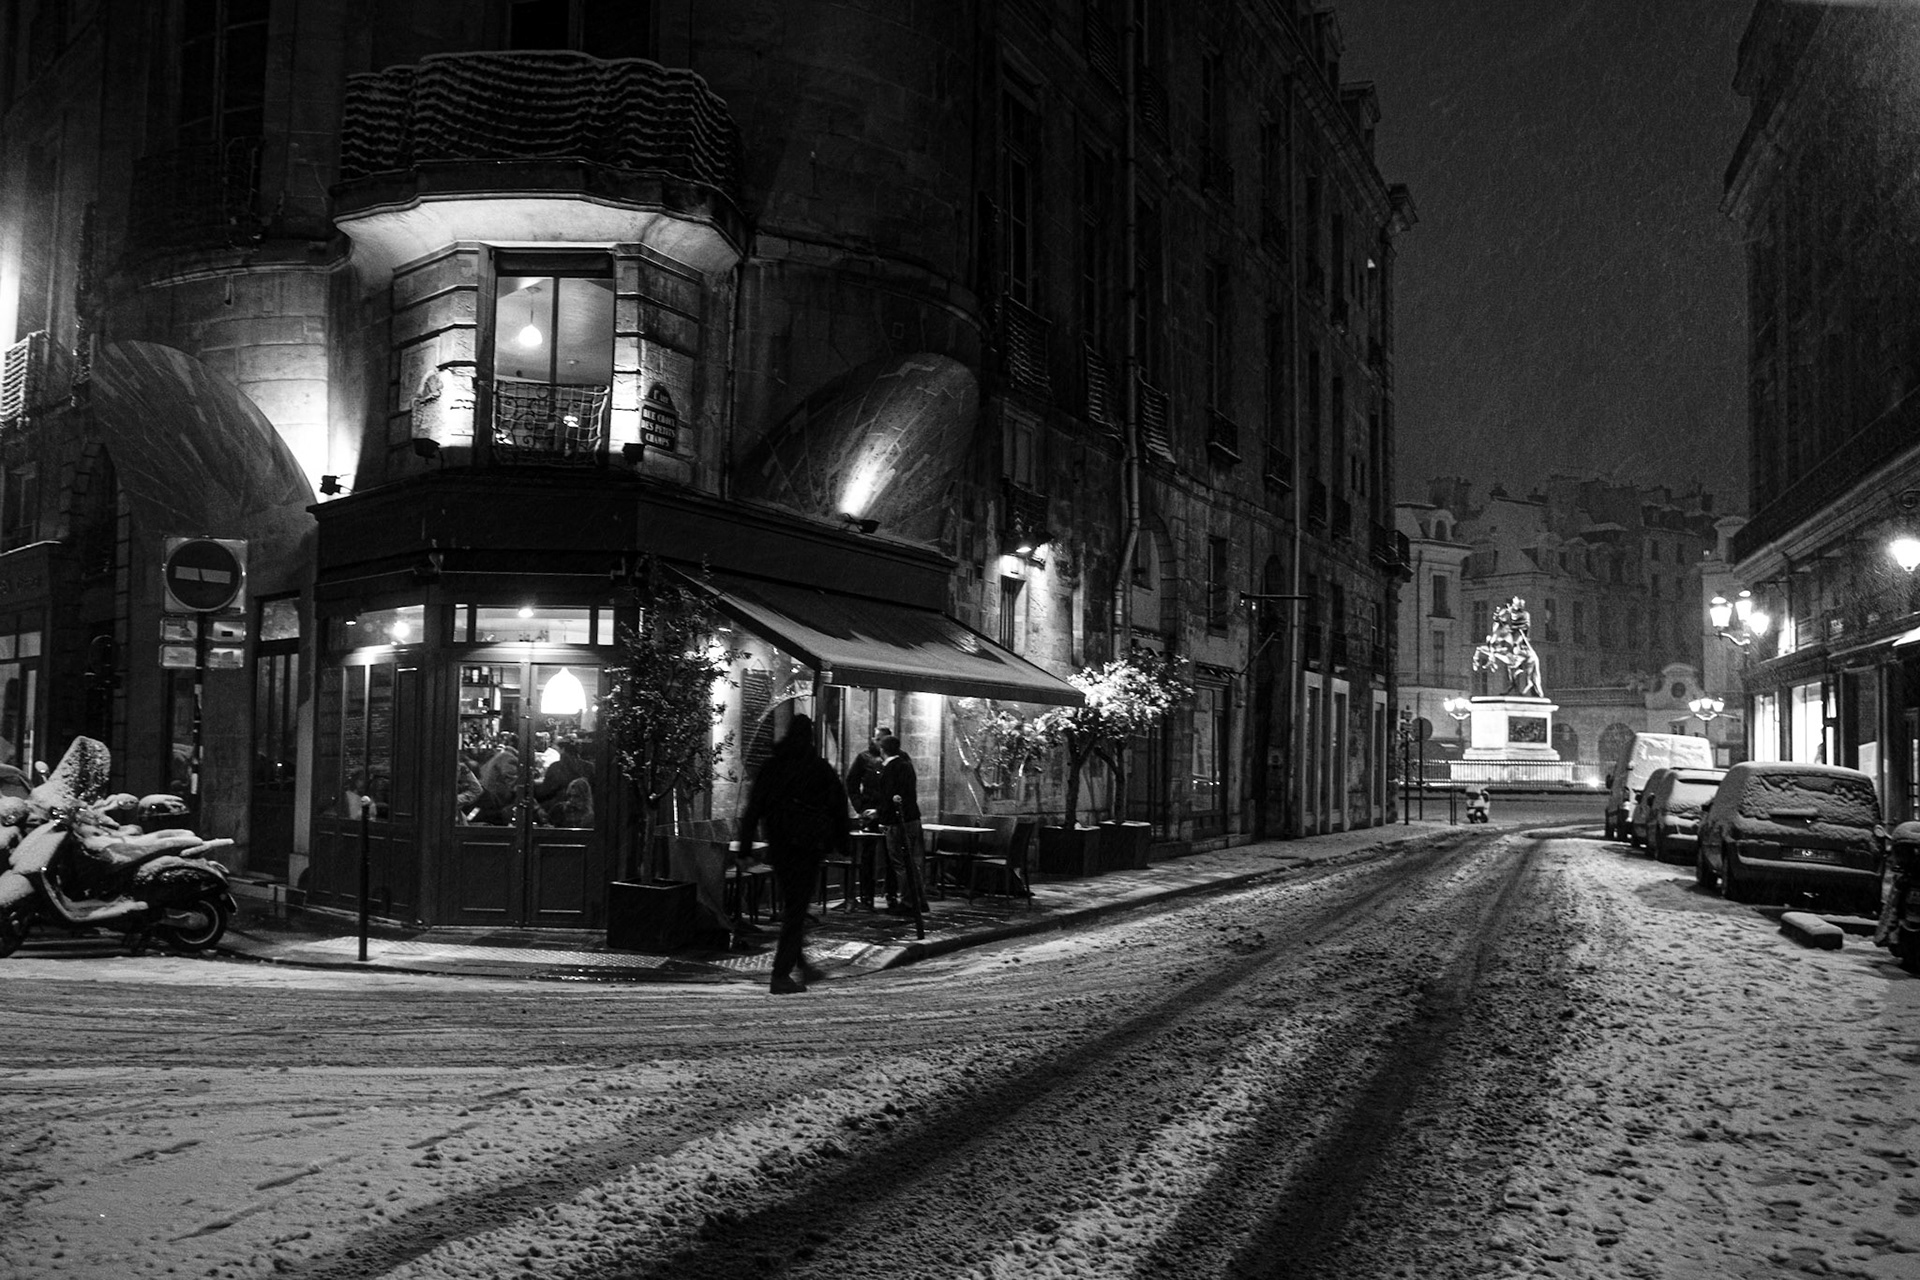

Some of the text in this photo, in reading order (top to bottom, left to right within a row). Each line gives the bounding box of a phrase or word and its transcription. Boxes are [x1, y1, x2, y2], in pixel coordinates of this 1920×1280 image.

[642, 408, 656, 421] RUE
[641, 419, 654, 431] DES
[645, 432, 670, 447] CHAMPS
